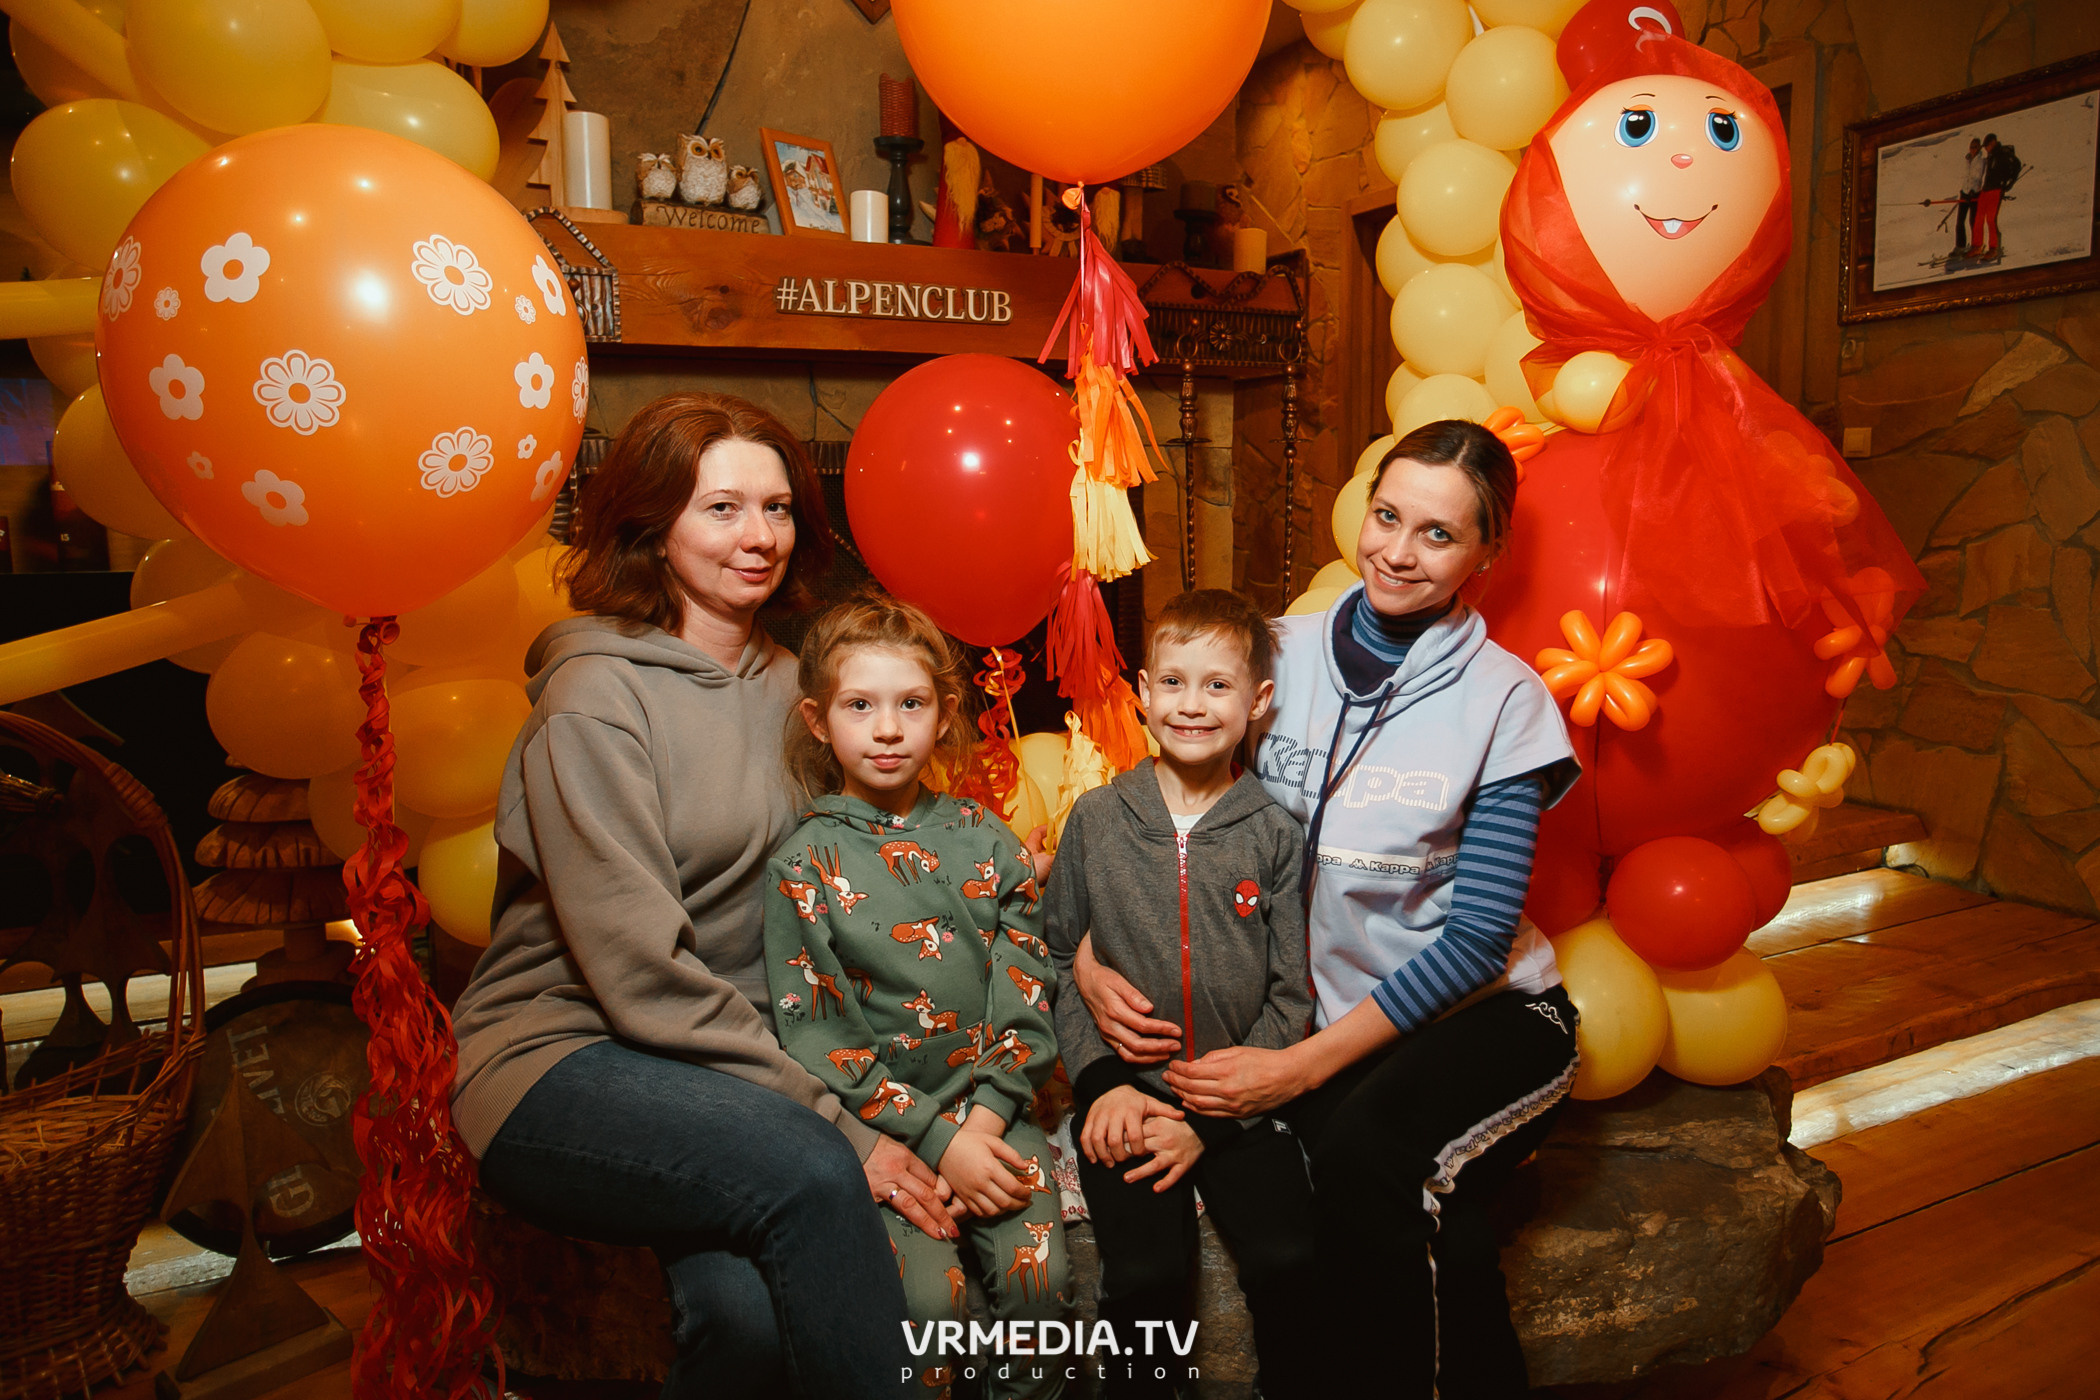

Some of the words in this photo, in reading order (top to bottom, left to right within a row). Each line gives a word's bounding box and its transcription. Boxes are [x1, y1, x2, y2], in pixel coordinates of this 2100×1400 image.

[656, 205, 760, 234] Welcome
[776, 277, 1013, 323] #ALPENCLUB
[1369, 860, 1421, 875] Kappa
[1434, 853, 1459, 868] Kapp
